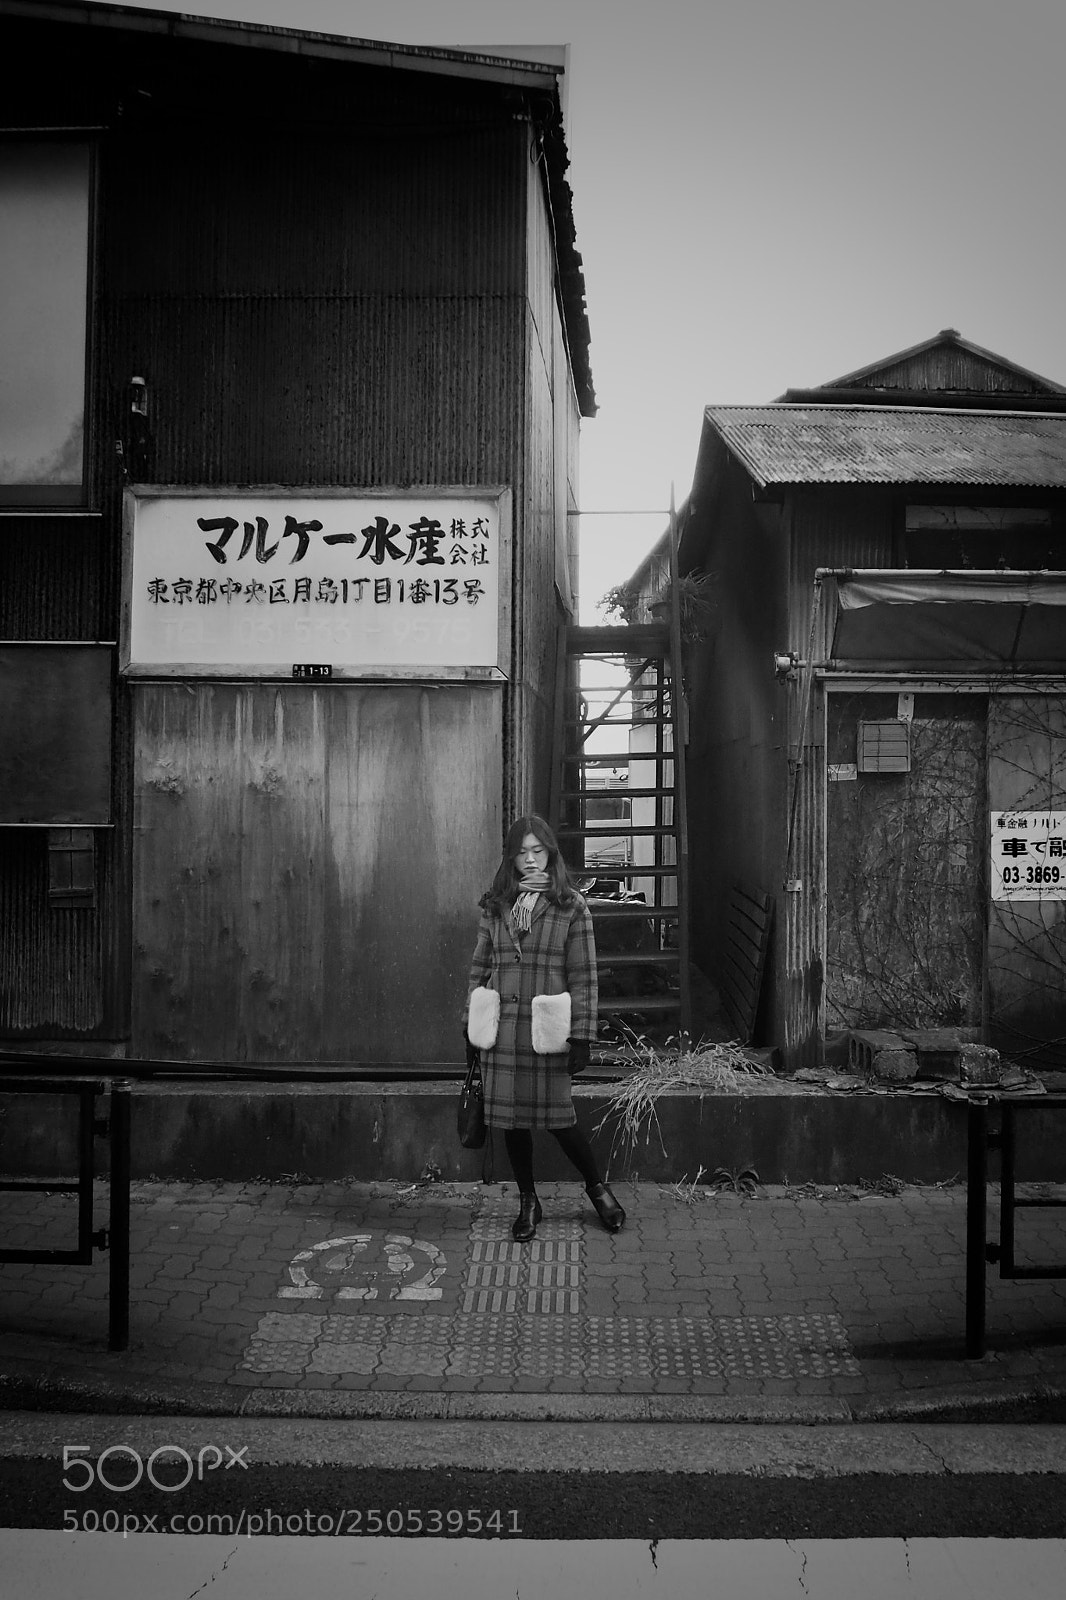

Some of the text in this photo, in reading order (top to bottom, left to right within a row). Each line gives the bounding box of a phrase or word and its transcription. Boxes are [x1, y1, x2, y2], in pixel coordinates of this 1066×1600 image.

[449, 517, 490, 540] 株式
[197, 516, 446, 566] マルケー水産
[448, 543, 491, 566] 会社
[309, 666, 329, 675] 1-13
